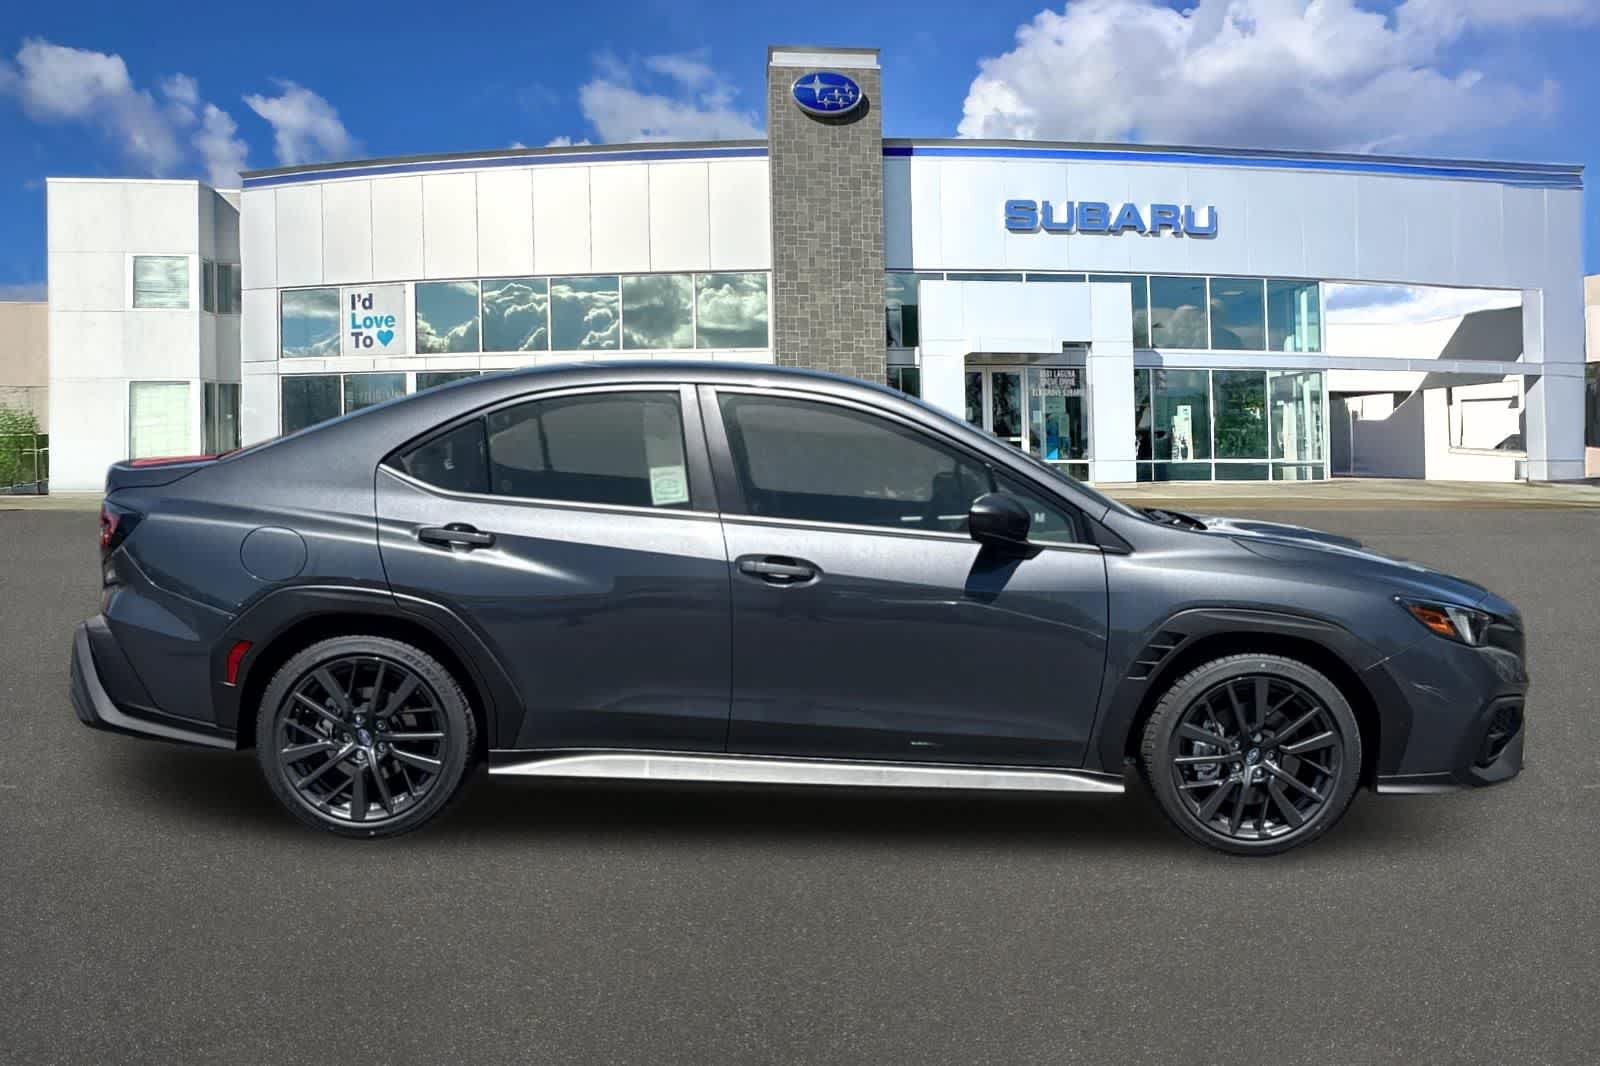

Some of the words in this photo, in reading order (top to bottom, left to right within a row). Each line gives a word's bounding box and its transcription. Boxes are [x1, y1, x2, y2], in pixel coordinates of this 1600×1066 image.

[1005, 199, 1218, 239] SUBARU
[351, 293, 373, 310] I'd
[351, 312, 396, 329] Love
[351, 331, 374, 348] To
